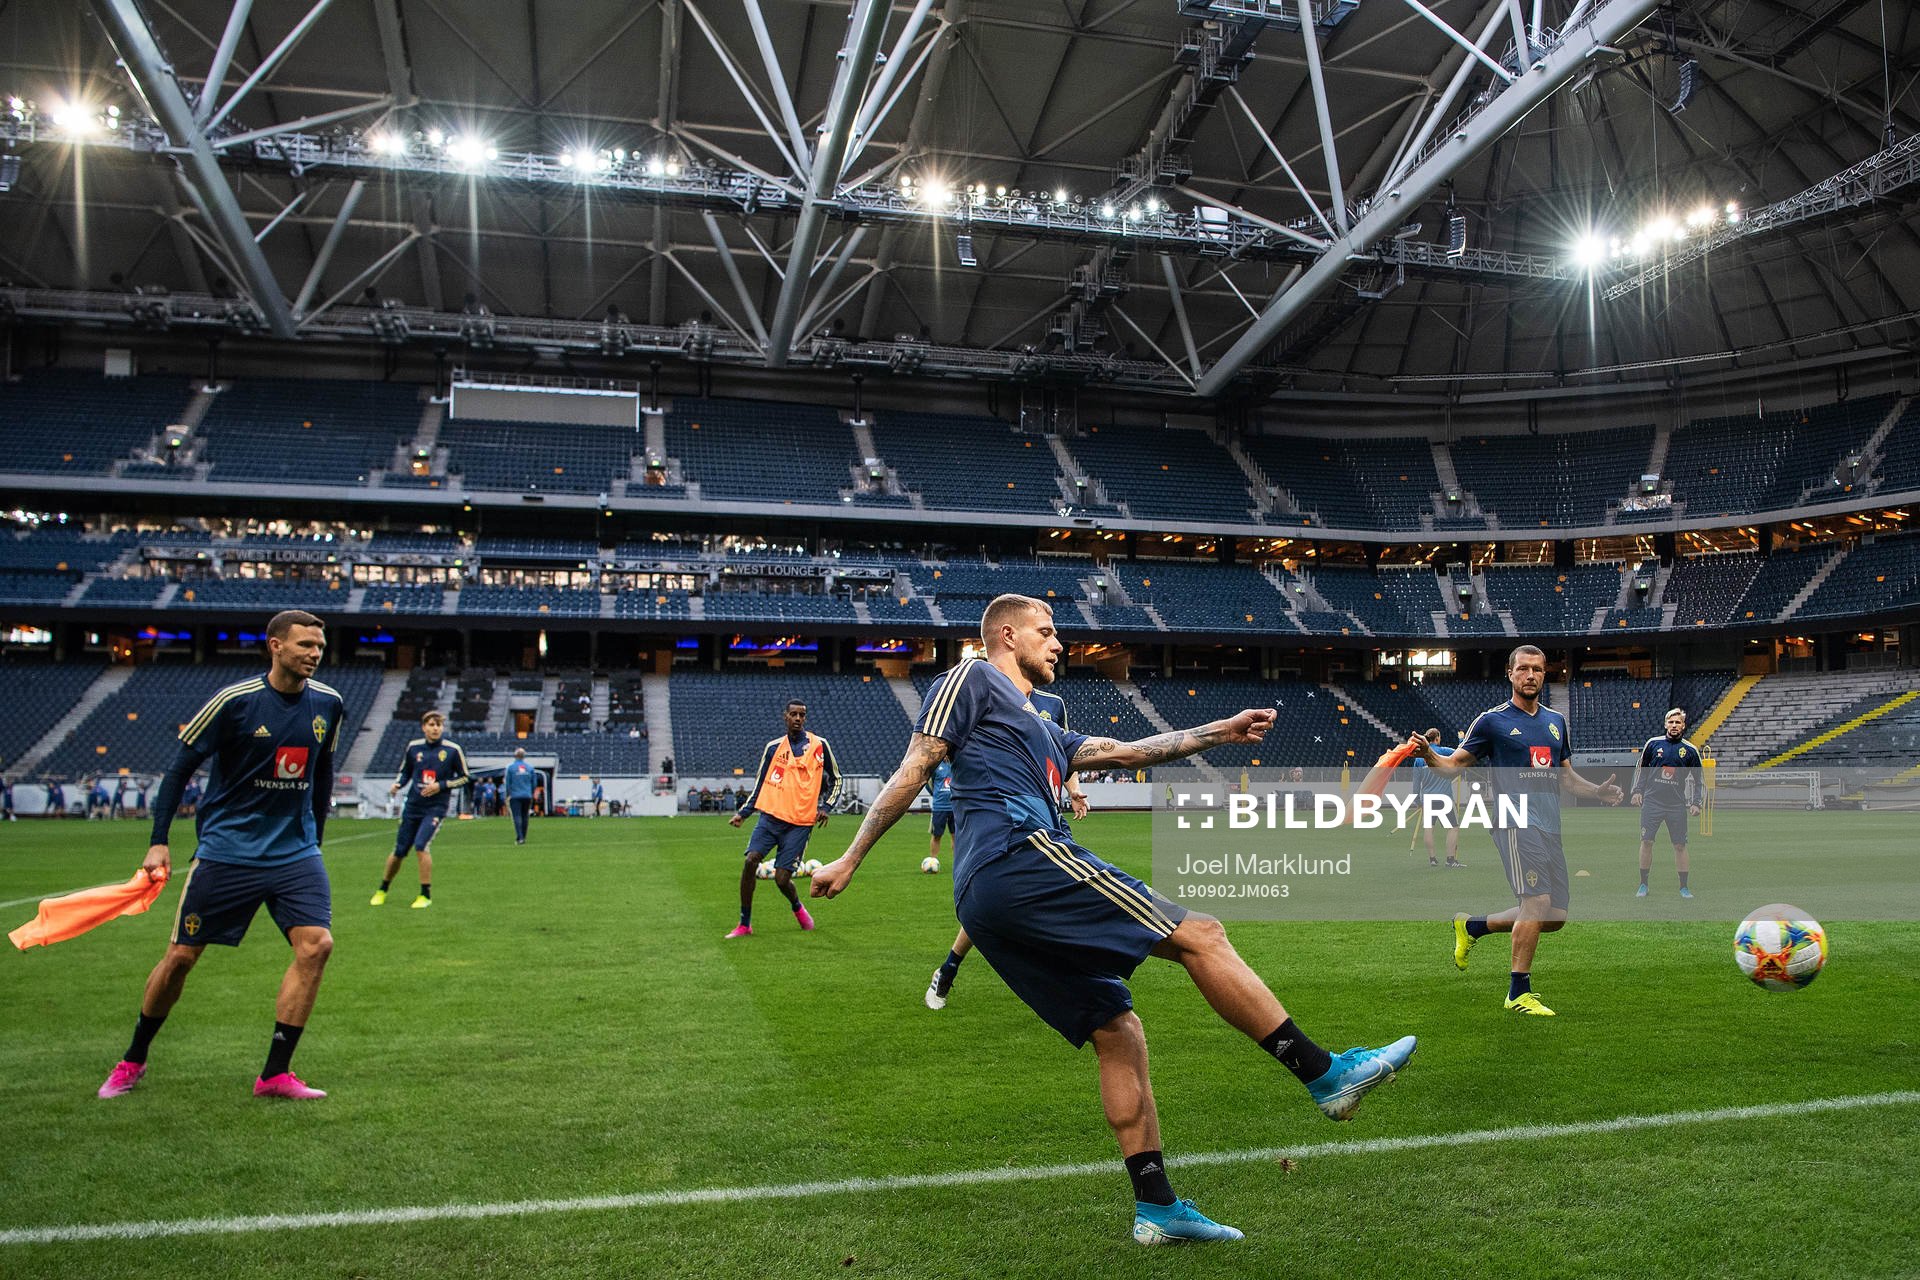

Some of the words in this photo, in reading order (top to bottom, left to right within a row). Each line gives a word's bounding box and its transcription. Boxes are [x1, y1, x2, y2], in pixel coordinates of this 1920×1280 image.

[237, 549, 272, 561] WEST
[733, 564, 766, 575] WEST
[768, 566, 815, 576] LOUNGE
[1519, 771, 1548, 779] SVENSKA
[254, 779, 295, 790] SVENSKA
